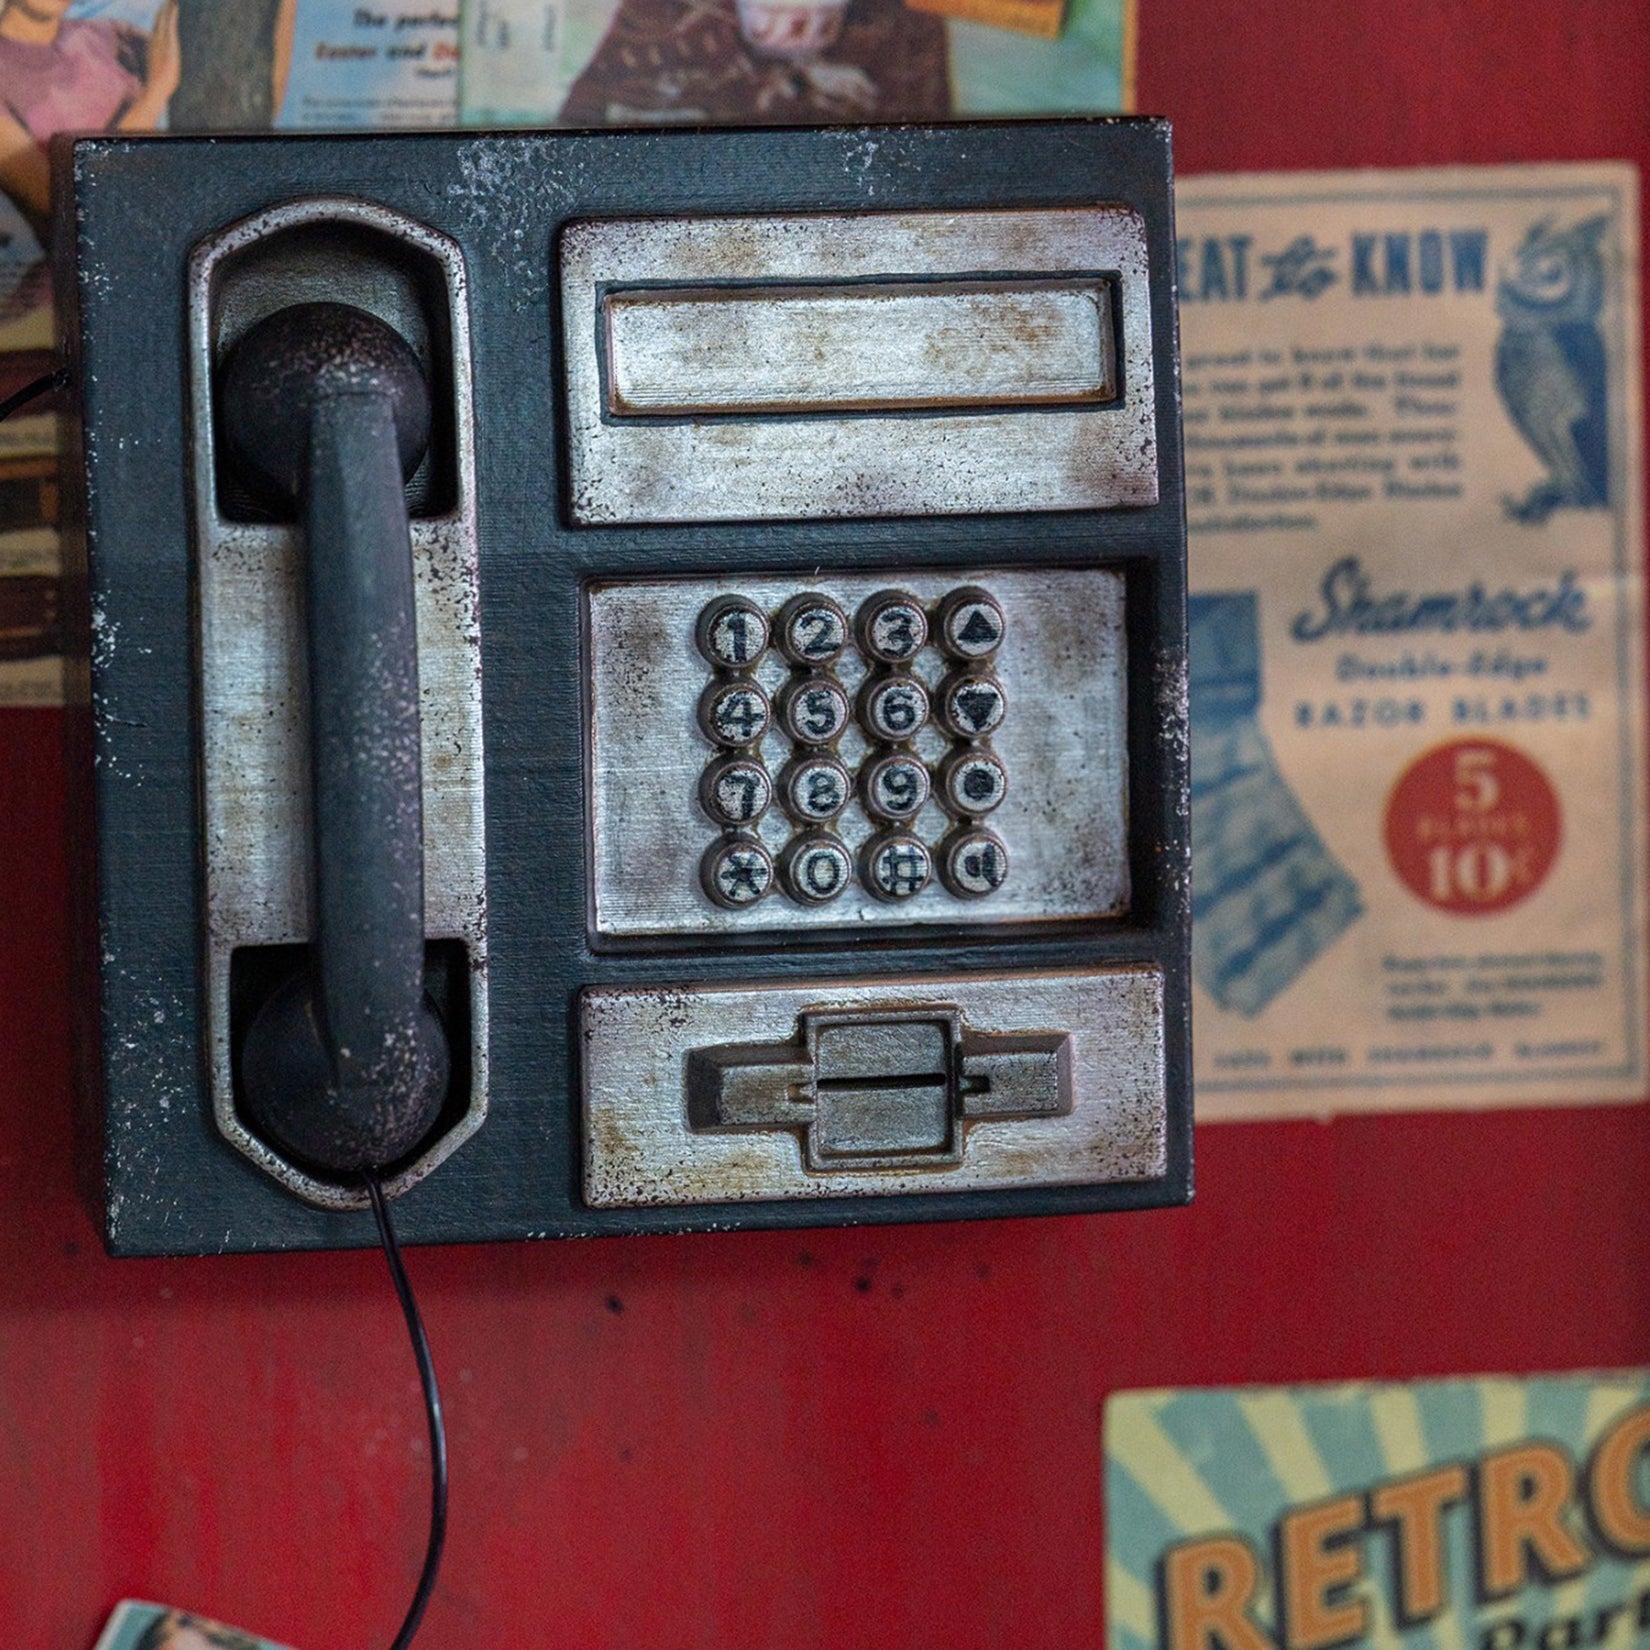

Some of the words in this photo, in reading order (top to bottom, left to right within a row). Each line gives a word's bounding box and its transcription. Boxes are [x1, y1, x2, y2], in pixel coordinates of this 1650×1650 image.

[386, 43, 426, 60] and
[1351, 230, 1488, 296] KNOW
[1291, 556, 1591, 642] Shamrock
[726, 610, 749, 661] 1
[799, 606, 842, 654] 2
[882, 605, 913, 656] 3
[720, 690, 765, 738] 4
[803, 689, 837, 735] 5
[883, 688, 915, 731] 6
[1294, 699, 1425, 729] RAZOR
[1451, 692, 1590, 727] BLADES
[724, 774, 760, 818] 7
[807, 772, 840, 812] 8
[882, 766, 917, 811] 9
[1454, 749, 1500, 812] 5
[807, 852, 840, 892] 0
